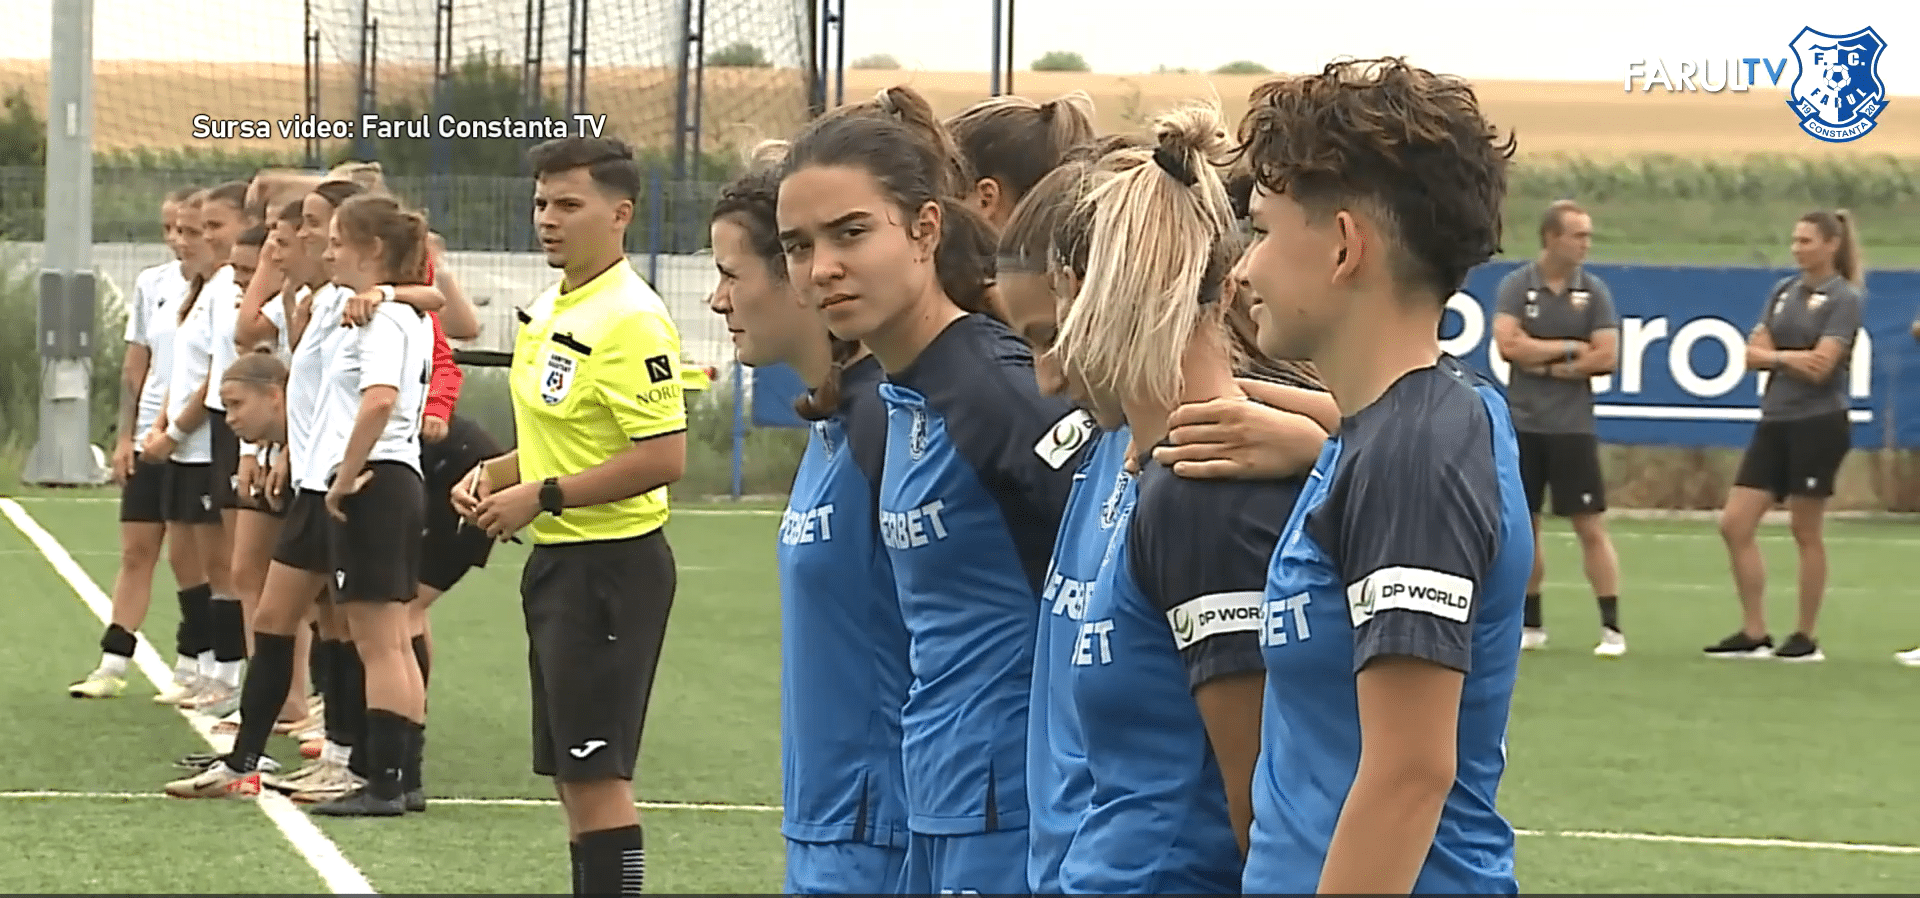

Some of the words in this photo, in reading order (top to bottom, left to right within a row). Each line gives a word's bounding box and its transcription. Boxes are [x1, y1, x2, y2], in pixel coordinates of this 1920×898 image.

[1383, 583, 1405, 598] DP
[1408, 585, 1468, 609] WORLD
[1217, 606, 1265, 621] WOR
